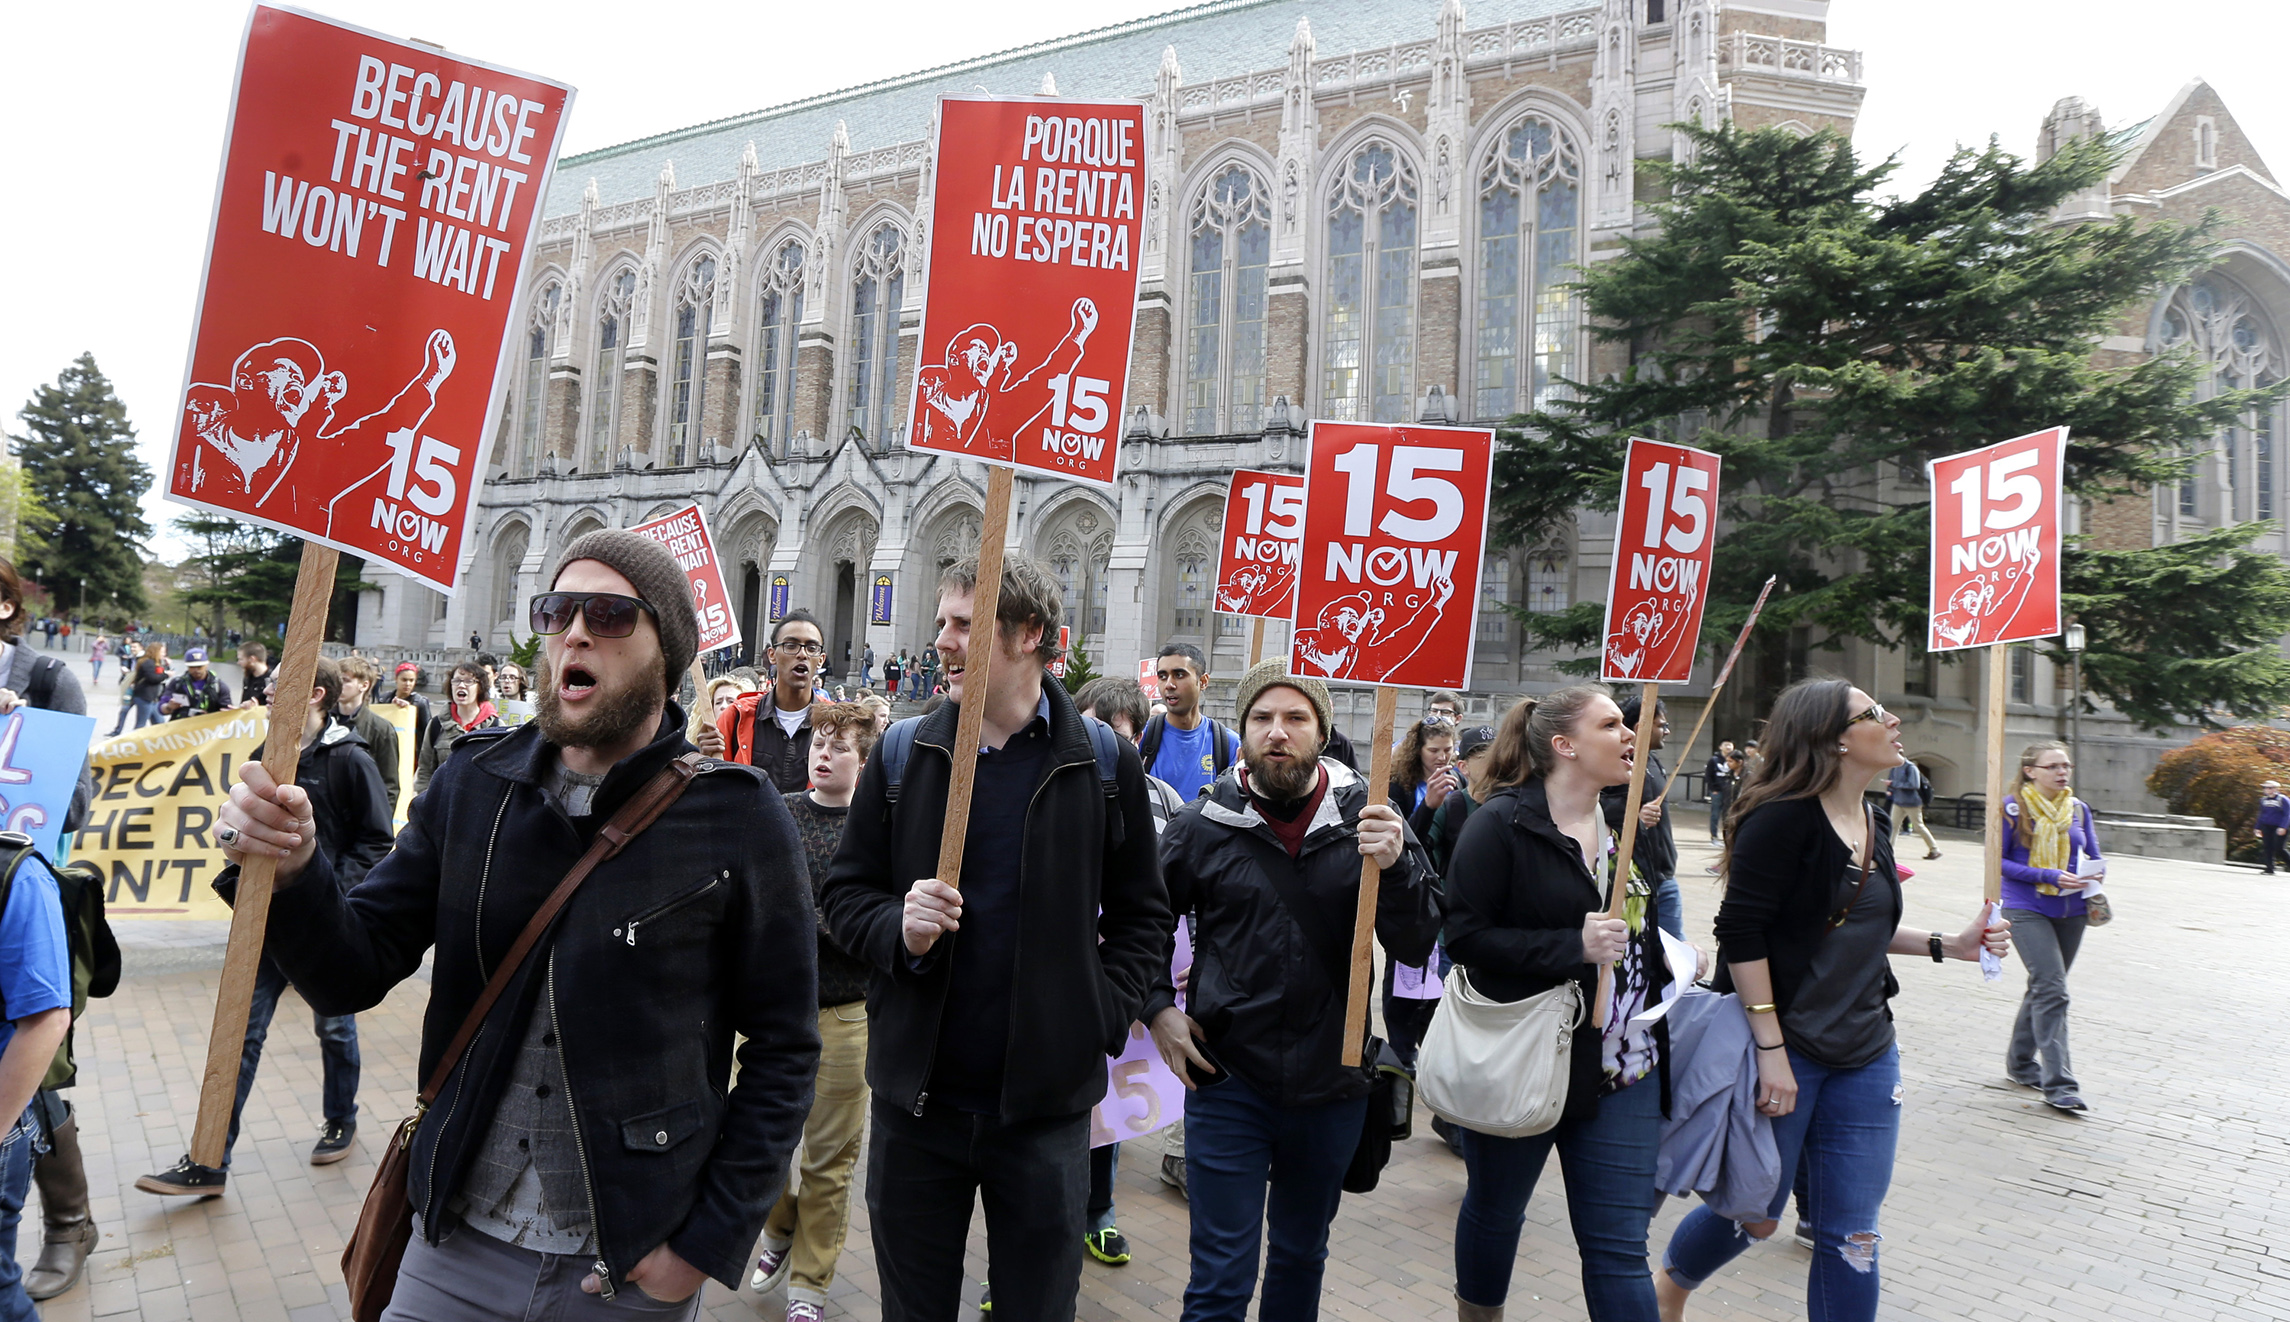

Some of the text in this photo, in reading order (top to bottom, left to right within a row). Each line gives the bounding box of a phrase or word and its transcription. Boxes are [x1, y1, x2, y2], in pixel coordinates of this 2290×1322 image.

[350, 53, 545, 165] BECAUSE
[1022, 115, 1136, 168] PORQUE
[330, 118, 528, 233] THE RENT
[991, 164, 1134, 220] LA RENTA
[261, 170, 511, 301] WON'T WAIT
[971, 212, 1129, 271] NO ESPERA
[1047, 372, 1110, 433] 15
[385, 426, 461, 516] 15
[1041, 427, 1106, 461] NOW
[1241, 482, 1303, 539] 15
[1334, 443, 1464, 542] 15
[1641, 461, 1709, 554] 15
[1951, 448, 2042, 538] 15
[370, 497, 450, 555] NOW
[669, 529, 704, 557] RENT
[1234, 536, 1299, 565] NOW
[1951, 525, 2042, 576] NOW
[1324, 541, 1459, 589] NOW
[1629, 552, 1702, 595] NOW
[696, 602, 726, 632] 15
[874, 586, 886, 621] Welcome
[701, 622, 728, 643] NOW
[144, 718, 255, 754] MINIMUM
